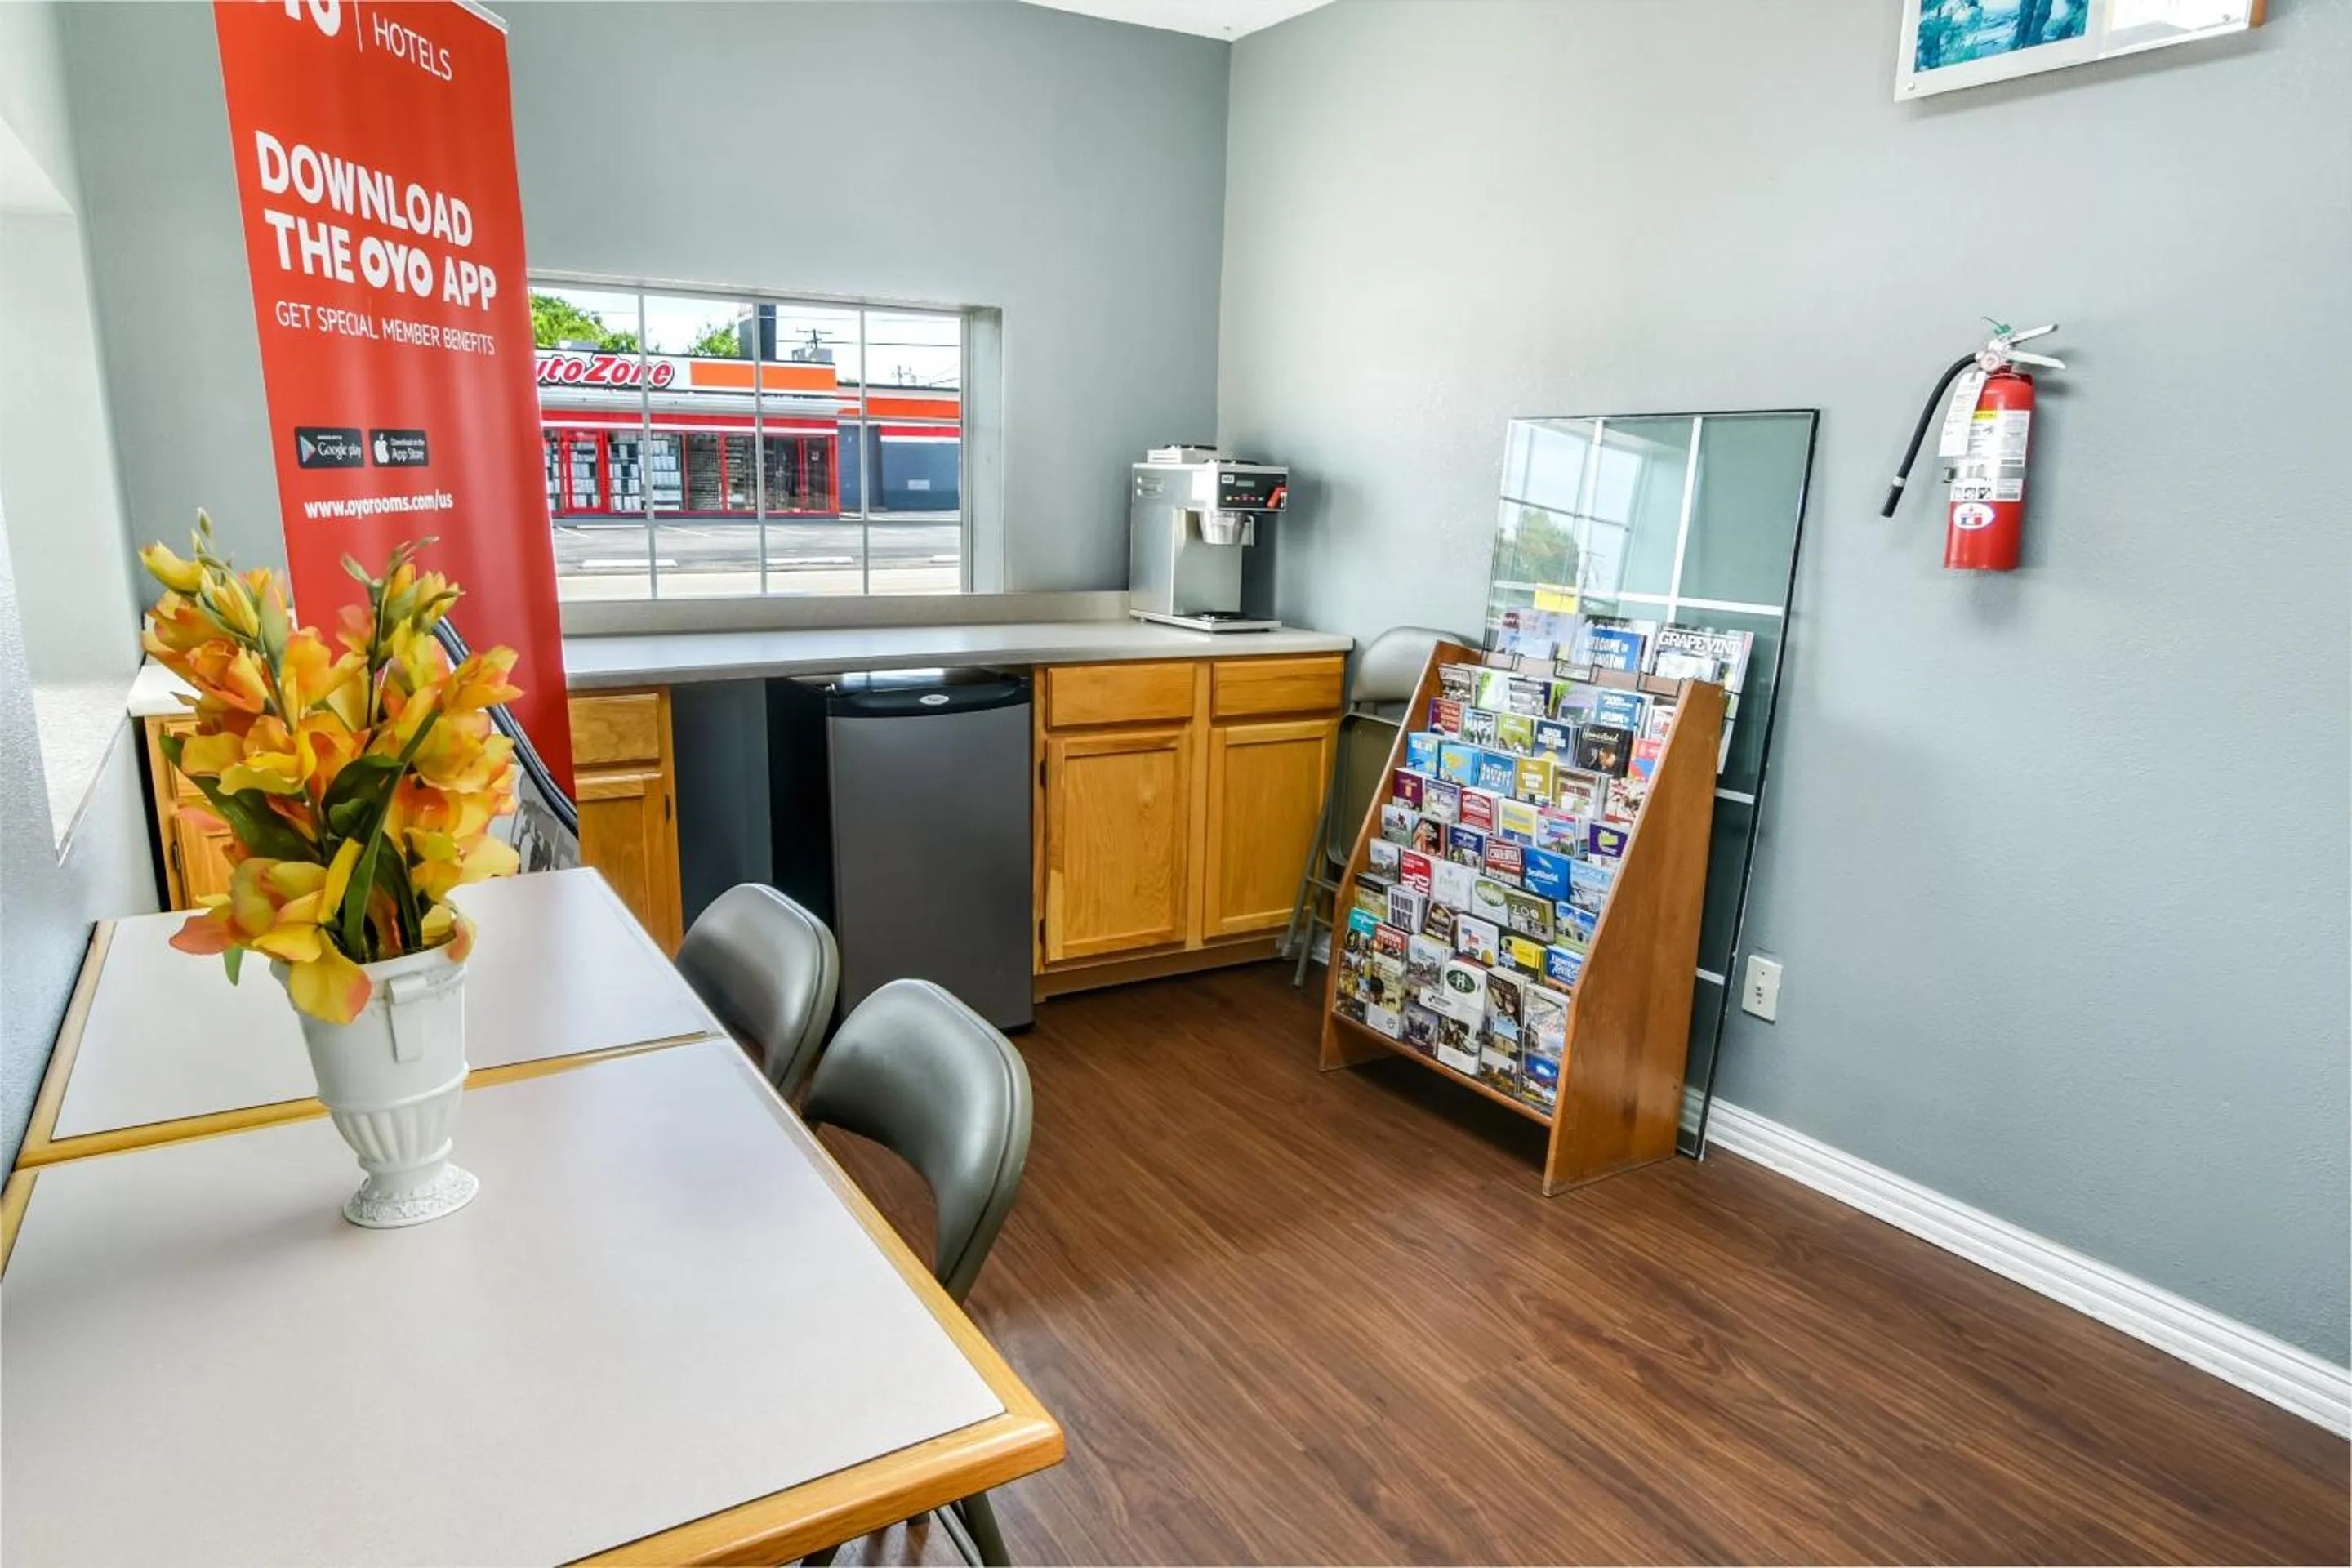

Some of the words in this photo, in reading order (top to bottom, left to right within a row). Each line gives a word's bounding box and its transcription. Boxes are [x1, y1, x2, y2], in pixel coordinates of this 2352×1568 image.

[372, 12, 452, 80] HOTELS
[256, 130, 473, 247] DOWNLOAD
[264, 208, 354, 283] THE
[359, 236, 434, 297] OYO
[443, 256, 497, 311] APP
[275, 300, 311, 327] GET
[317, 306, 379, 339] SPECIAL
[382, 318, 441, 348] MEMBER
[443, 328, 495, 355] BENEFITS
[536, 354, 675, 388] utoZone
[318, 442, 347, 460] Google
[392, 448, 407, 462] App
[305, 488, 453, 519] www.oyorooms.com/us
